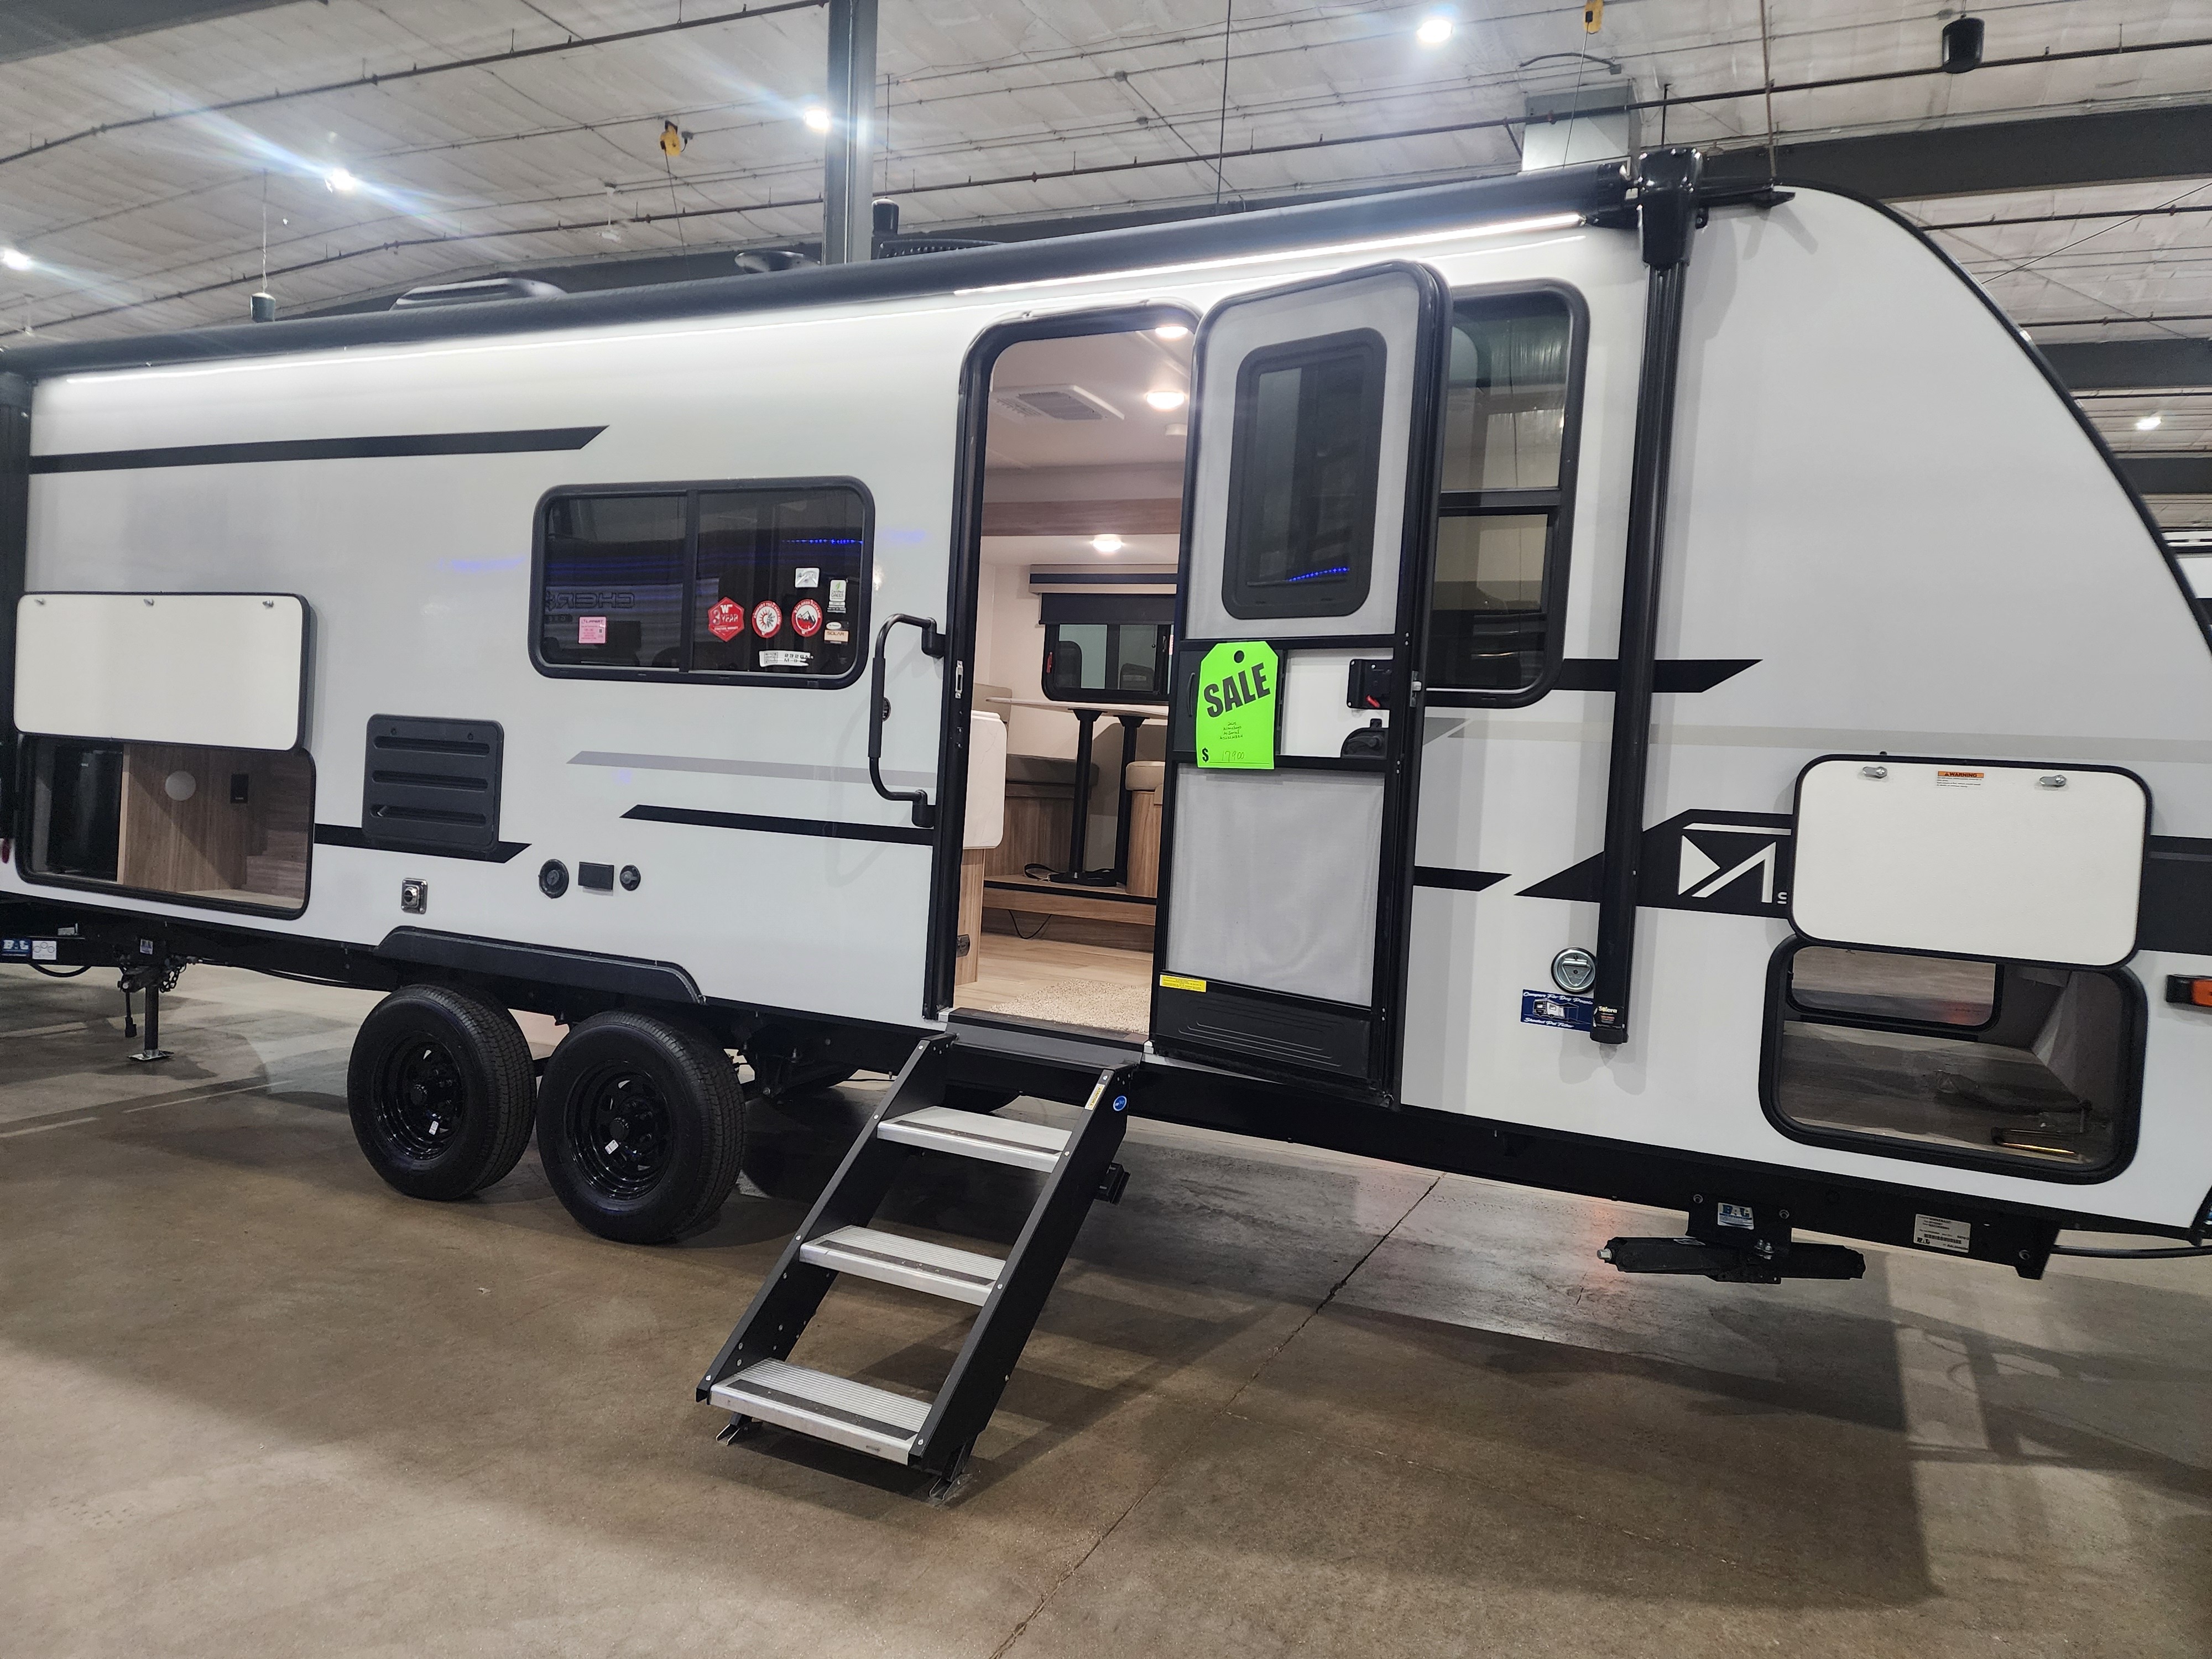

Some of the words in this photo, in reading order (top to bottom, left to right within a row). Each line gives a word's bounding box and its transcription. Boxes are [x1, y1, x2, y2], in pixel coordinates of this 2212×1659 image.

[713, 609, 721, 625] 3
[721, 614, 738, 623] YEAR
[1204, 662, 1270, 718] SALE
[1202, 747, 1209, 763] $
